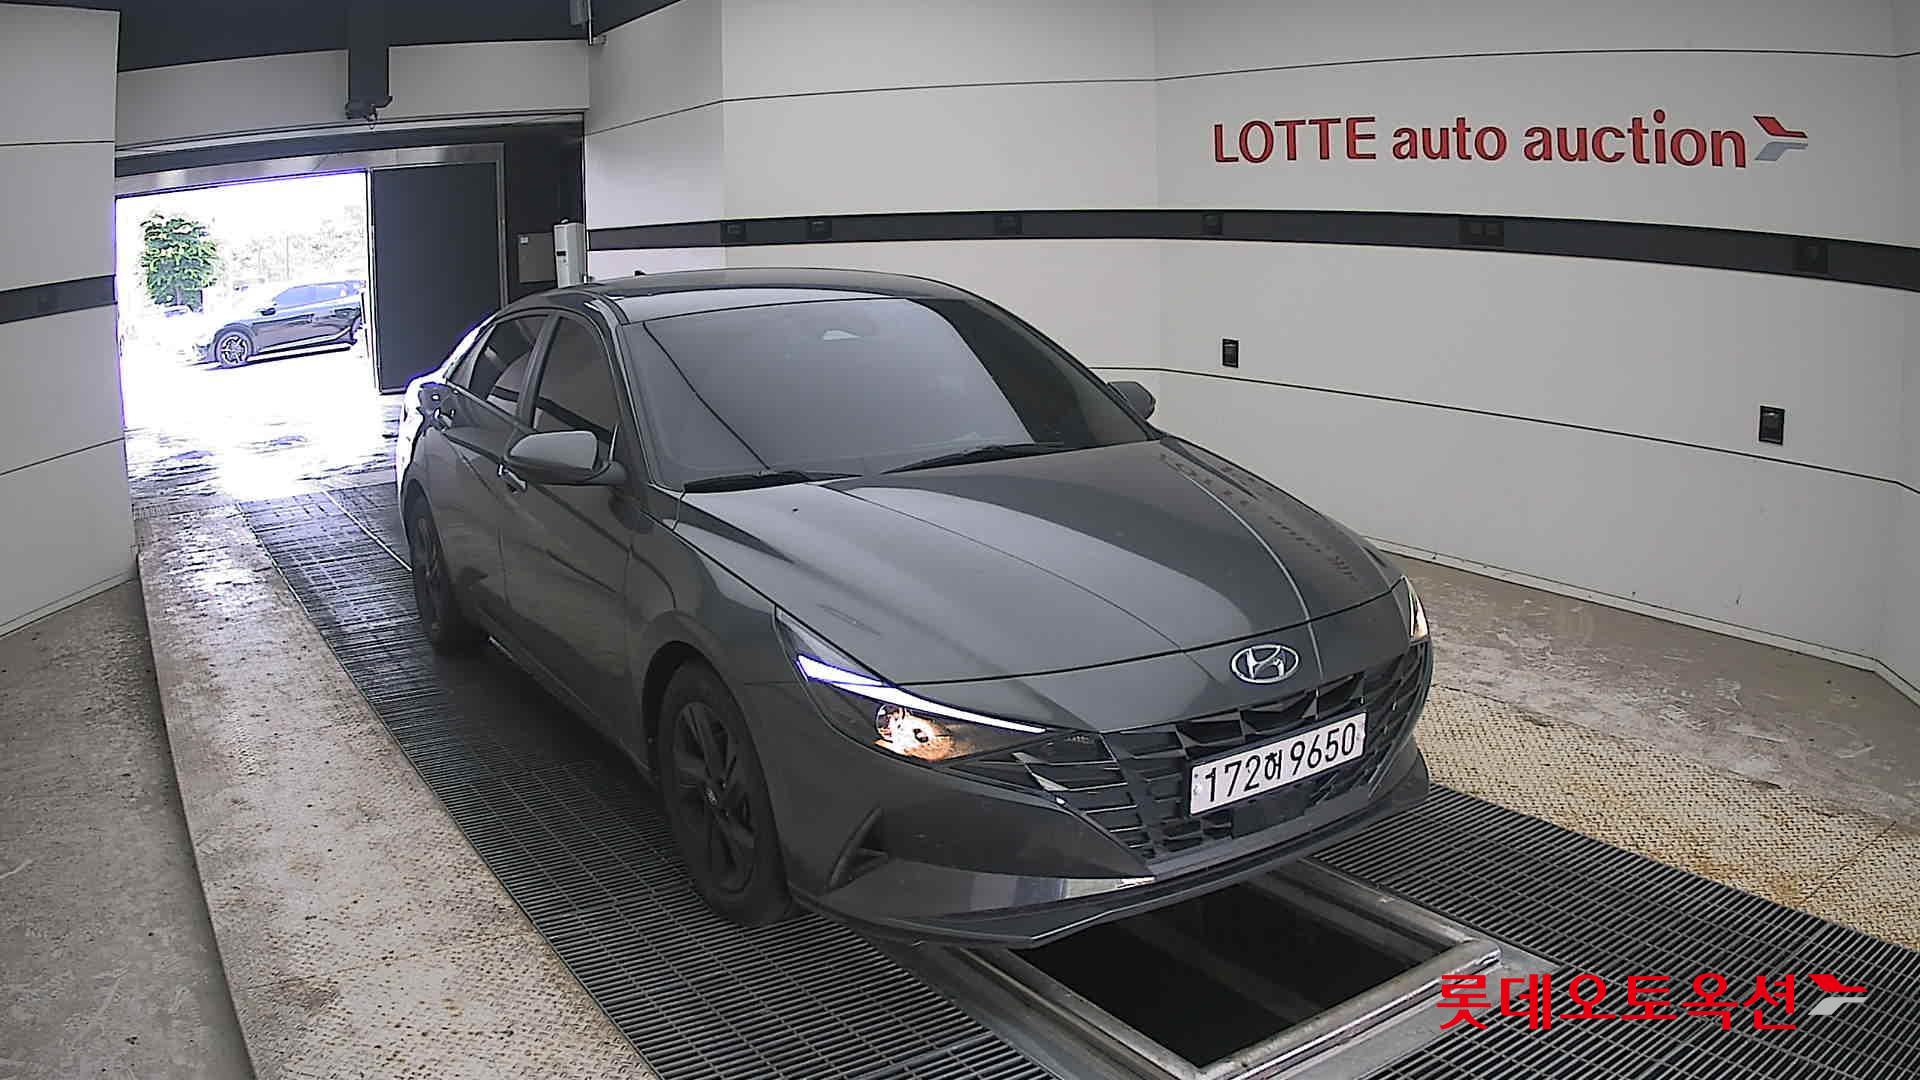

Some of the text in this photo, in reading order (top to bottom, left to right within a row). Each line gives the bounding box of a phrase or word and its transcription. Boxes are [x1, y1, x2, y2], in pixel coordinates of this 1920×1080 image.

[1213, 109, 1747, 168] LOTTE auto auction
